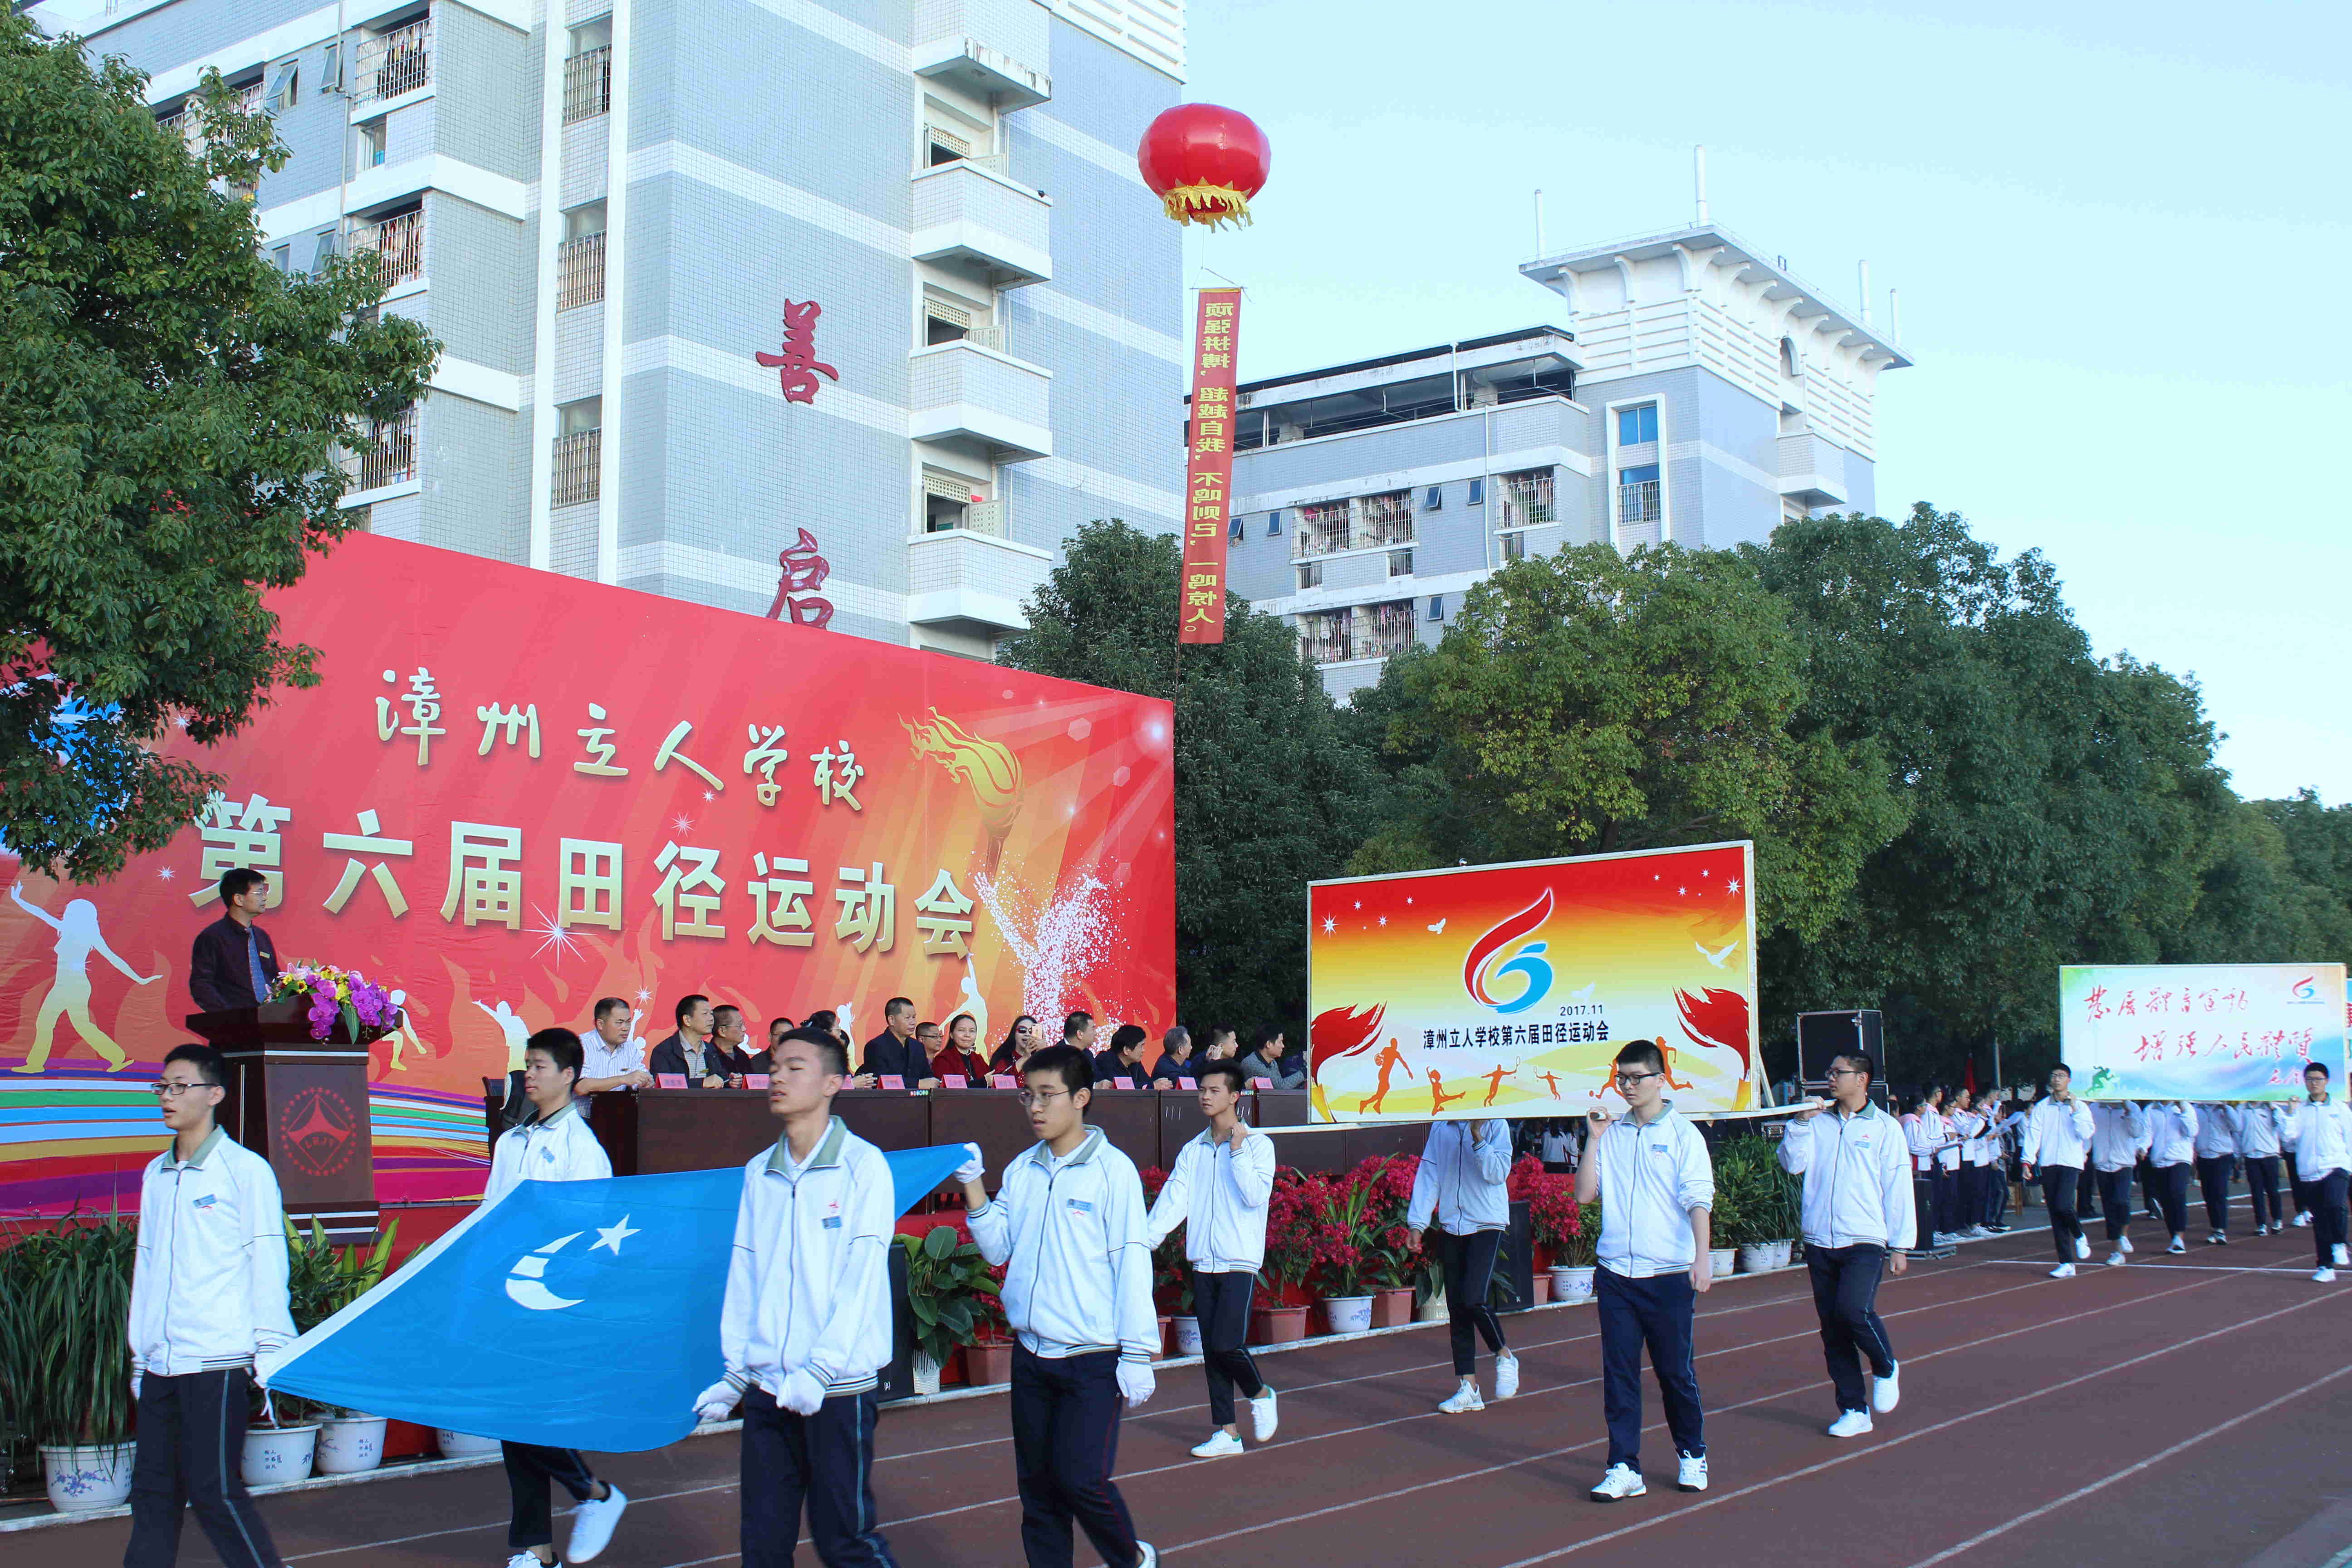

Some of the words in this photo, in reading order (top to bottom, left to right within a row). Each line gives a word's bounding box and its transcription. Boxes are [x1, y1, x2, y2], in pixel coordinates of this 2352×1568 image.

[377, 667, 866, 811] 漳州立人学校
[188, 789, 975, 958] 第六届田径运动会
[1423, 1020, 1609, 1050] 漳州立人学校第六届田径运动会
[1559, 1004, 1603, 1016] 2017.11
